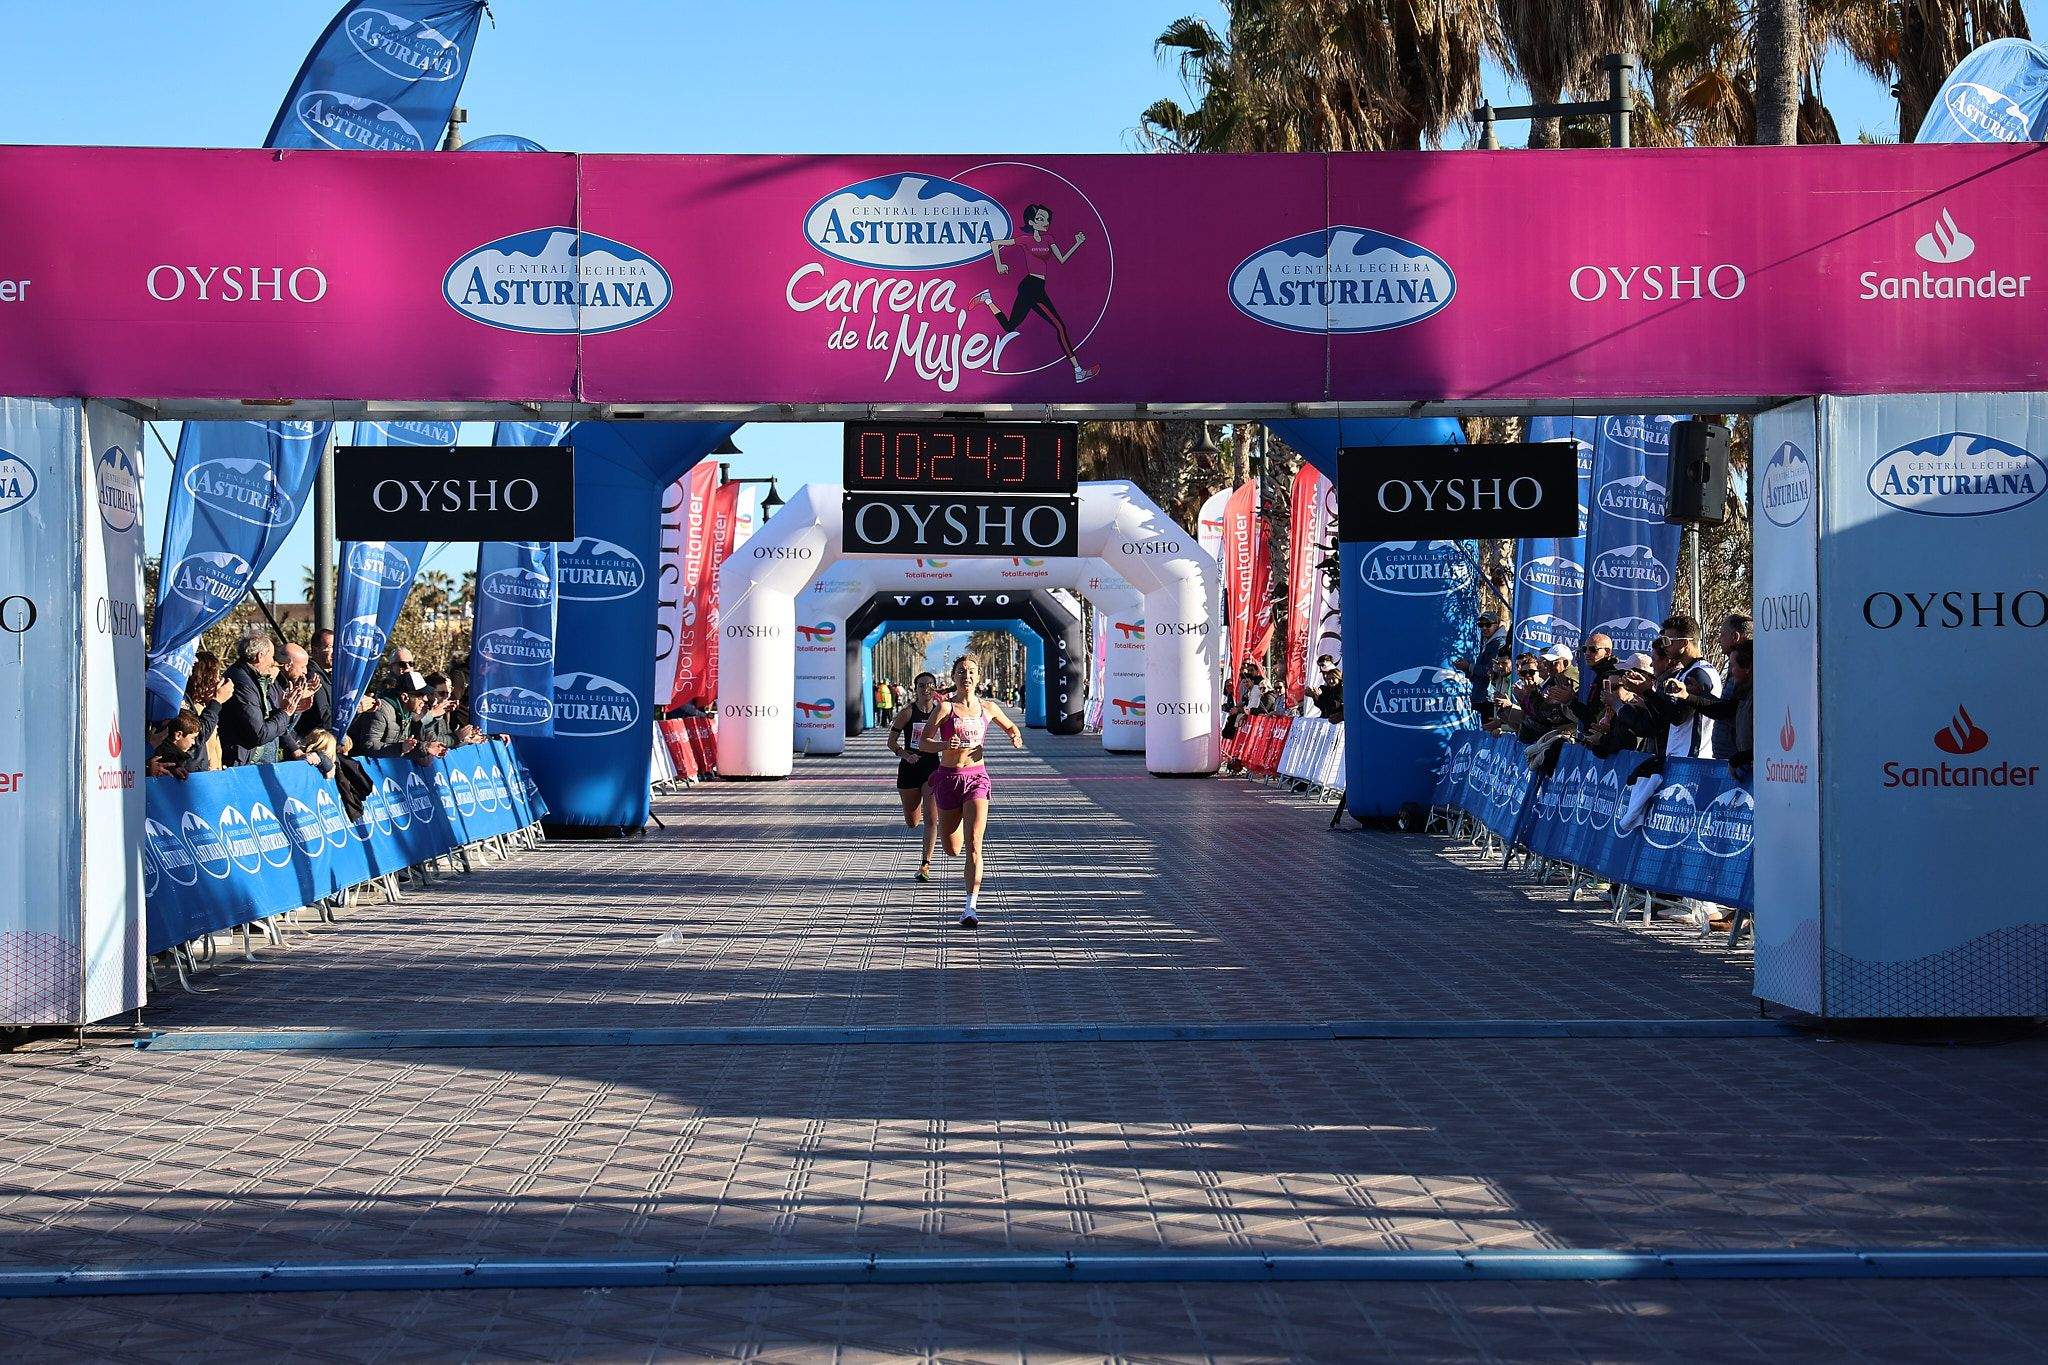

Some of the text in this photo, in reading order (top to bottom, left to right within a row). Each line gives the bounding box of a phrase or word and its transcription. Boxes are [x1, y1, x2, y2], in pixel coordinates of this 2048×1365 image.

[819, 208, 997, 245] ASTURIANA
[852, 206, 990, 216] CENTRAL LECHERA
[146, 264, 327, 303] OYSHO
[496, 264, 647, 276] CENTRAL LECHERA
[1281, 263, 1431, 275] CENTRAL LECHERA
[1569, 264, 1746, 301] OYSHO
[461, 266, 655, 307] ASTURIANA
[786, 262, 956, 314] Carrera
[1247, 267, 1438, 306] ASTURIANA
[1859, 270, 2031, 300] Santander
[827, 309, 1021, 392] de la Mujer
[860, 432, 1061, 482] 00:24:31
[1908, 461, 2030, 470] CENTRAL LECHERA
[1378, 477, 1542, 513] OYSHO
[1881, 464, 2036, 495] ASTURIANA
[372, 478, 539, 513] OYSHO
[855, 502, 1067, 548] OYSHO
[683, 493, 703, 597] Santander
[753, 547, 812, 559] OYSHO
[1122, 541, 1180, 555] OYSHO
[1235, 513, 1249, 603] Santander
[1001, 570, 1048, 578] TotalEnergies
[894, 595, 1010, 607] VOLVO
[1762, 592, 1811, 632] OYSHO
[1863, 590, 2048, 629] OYSHO
[96, 597, 138, 639] OYSHO
[726, 625, 781, 638] OYSHO
[1155, 623, 1209, 636] OYSHO
[482, 638, 552, 659] ASTURIANA
[675, 630, 697, 692] Sports
[1058, 640, 1068, 722] VOLVO
[479, 698, 549, 718] ASTURIANA
[725, 705, 779, 718] OYSHO
[1157, 702, 1210, 715] OYSHO
[98, 765, 135, 790] Santander
[1766, 758, 1808, 784] Santander
[1882, 761, 2040, 787] Santander
